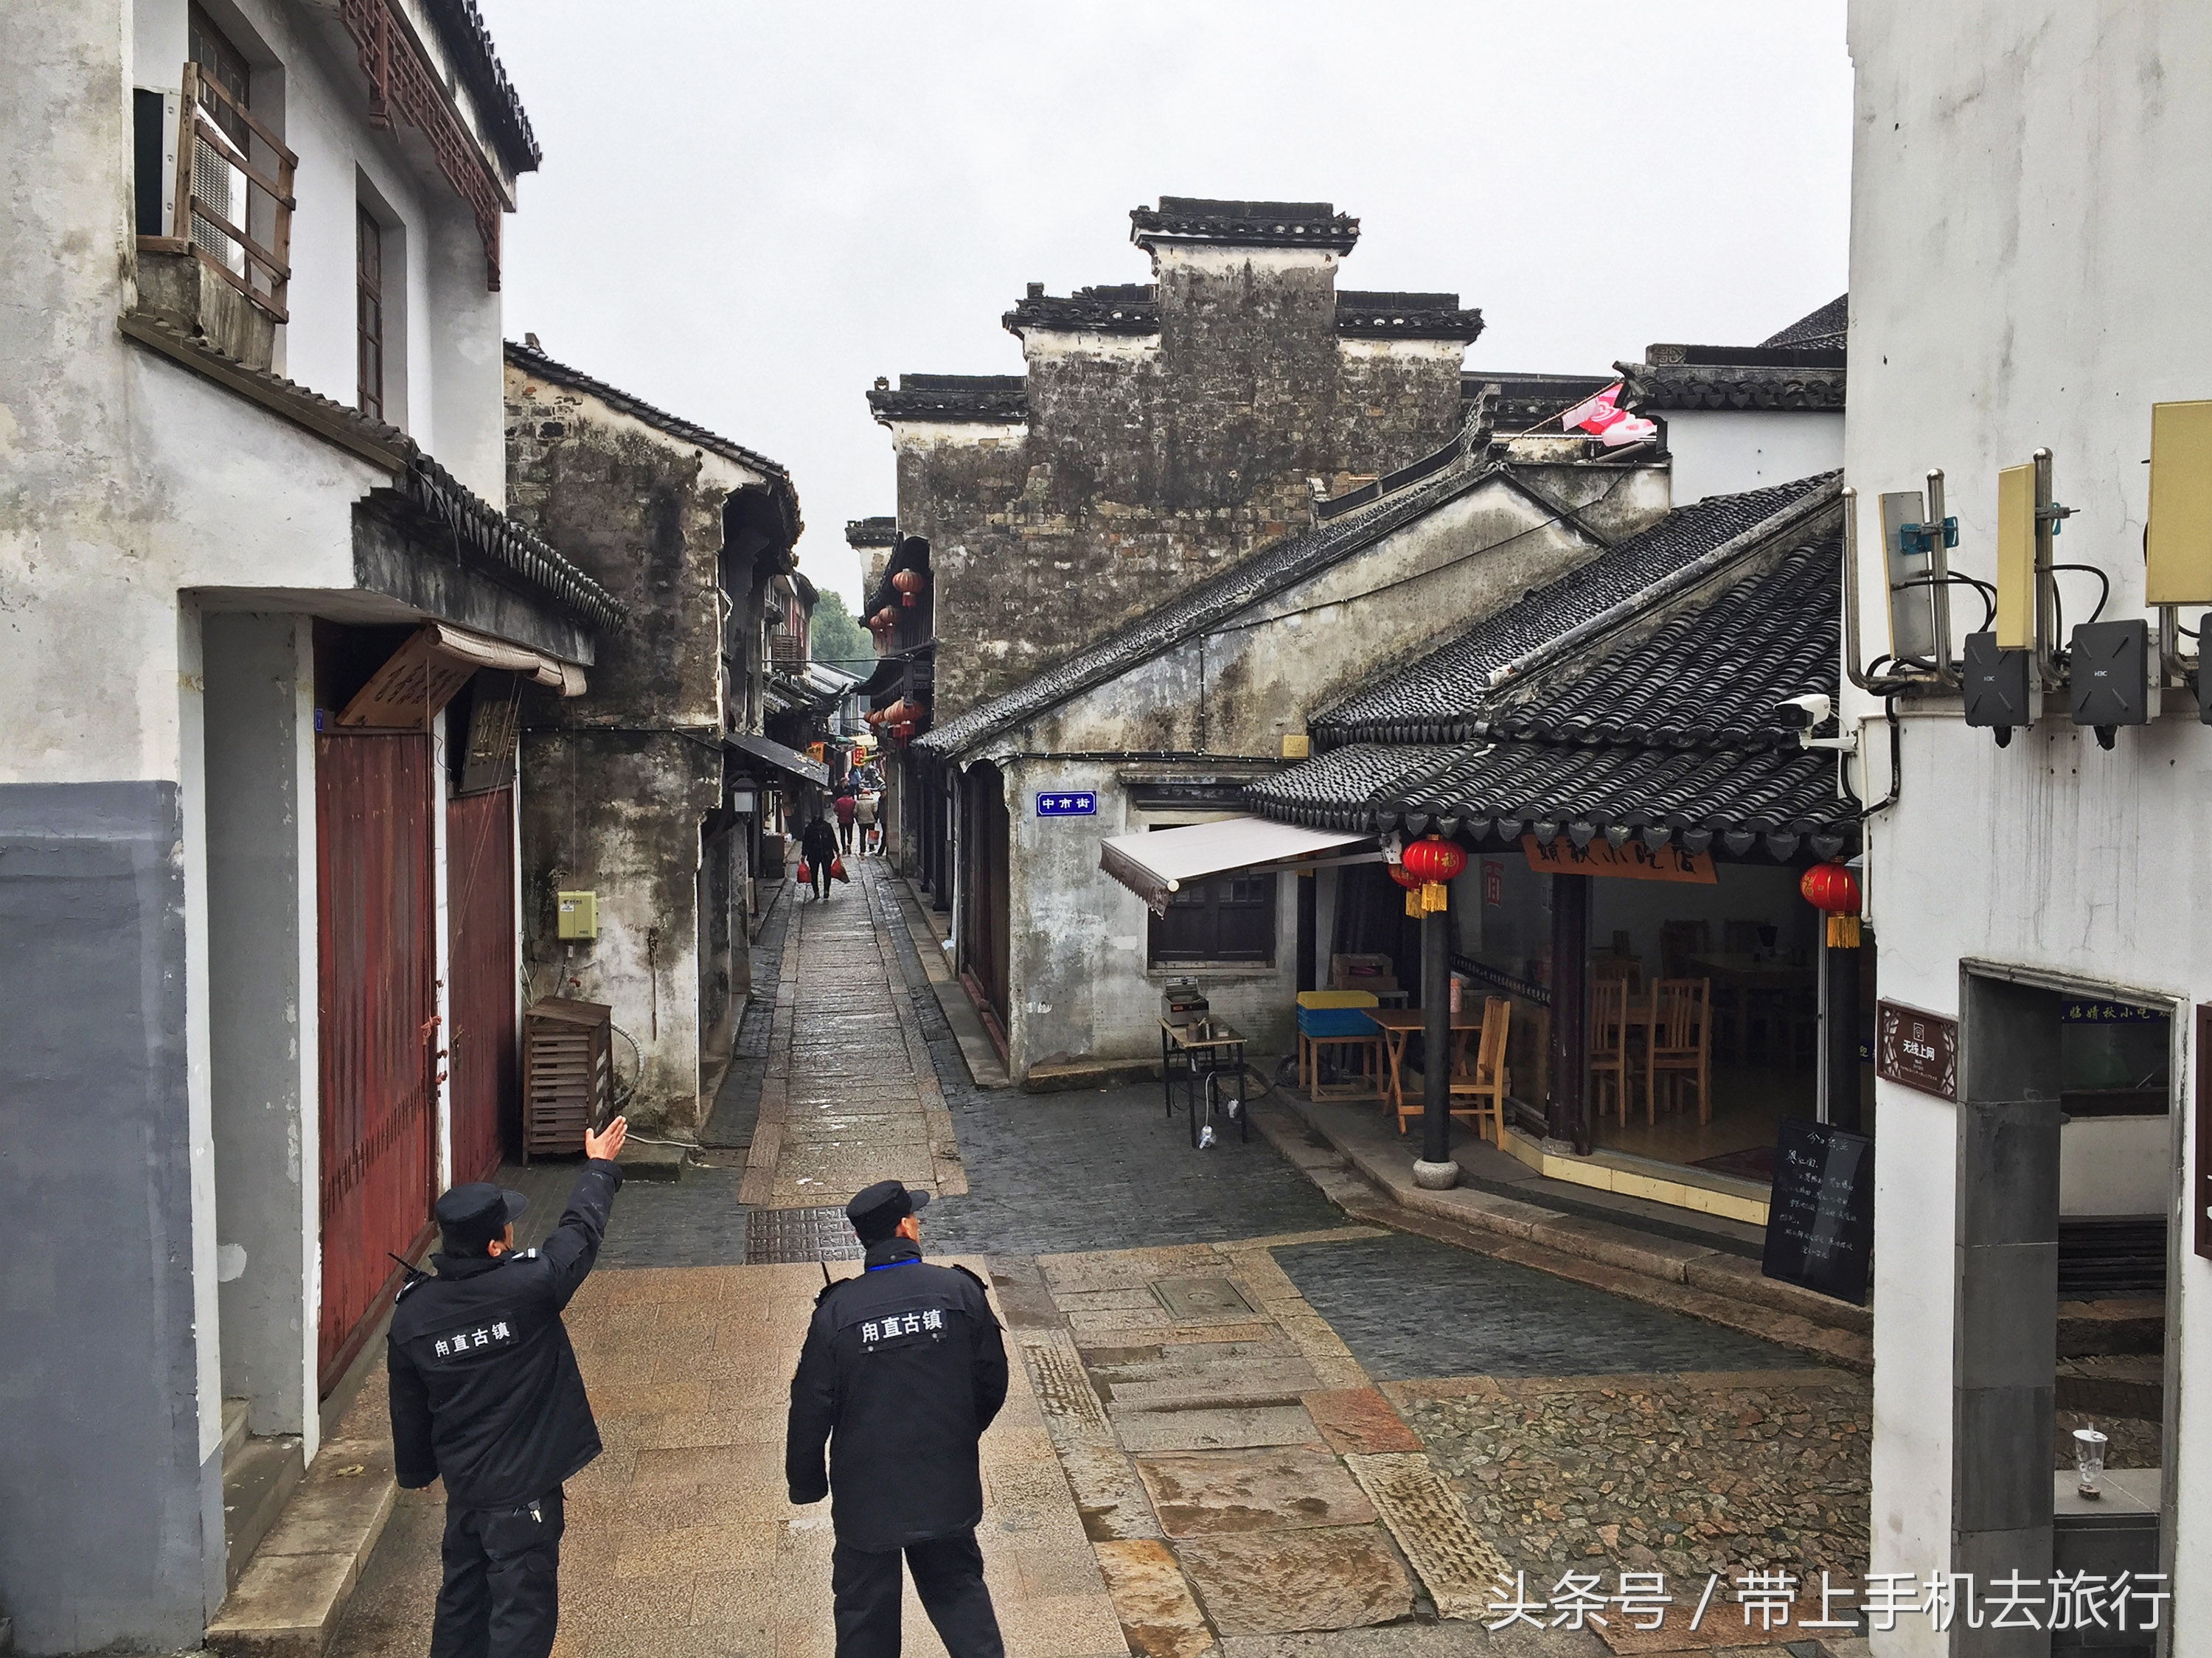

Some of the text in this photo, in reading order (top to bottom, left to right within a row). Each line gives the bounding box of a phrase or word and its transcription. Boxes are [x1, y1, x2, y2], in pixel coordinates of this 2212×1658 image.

[1042, 797, 1091, 809] 中市街
[1902, 1039, 1935, 1062] 无线上网
